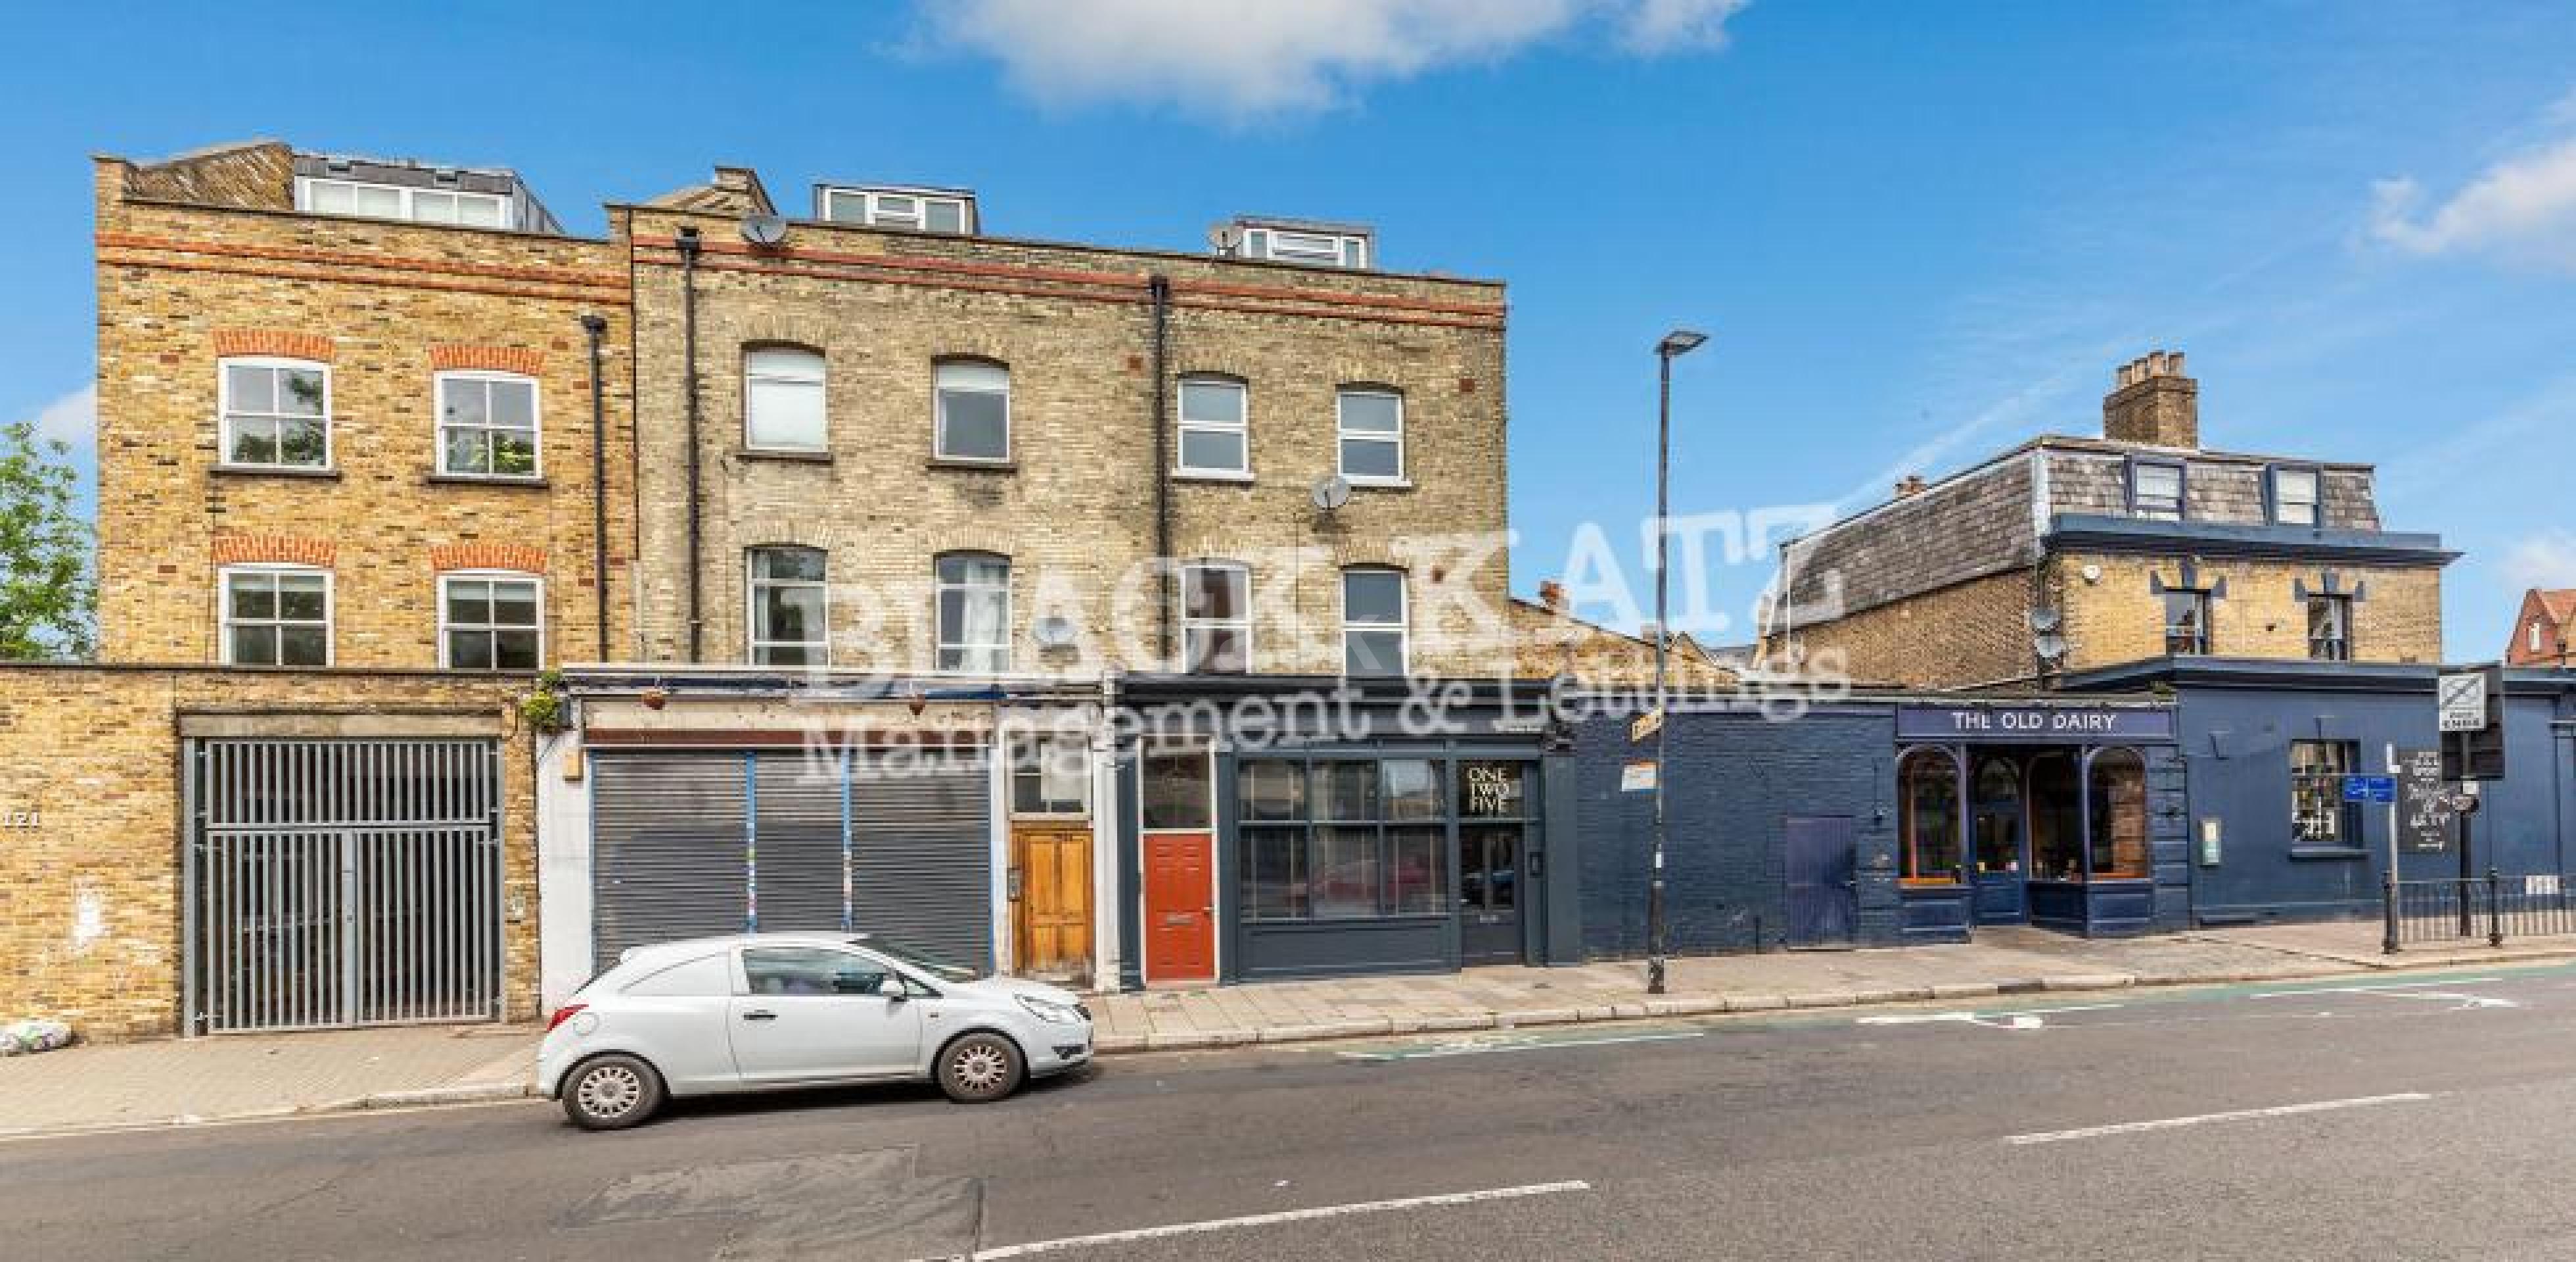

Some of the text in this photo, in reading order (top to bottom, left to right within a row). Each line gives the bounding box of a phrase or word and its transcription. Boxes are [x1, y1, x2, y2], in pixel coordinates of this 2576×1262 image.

[1952, 712, 2117, 729] THE OLD DAIRY
[1467, 766, 1507, 782] ONE
[1469, 782, 1509, 797] TWO
[1469, 797, 1508, 812] FIVE
